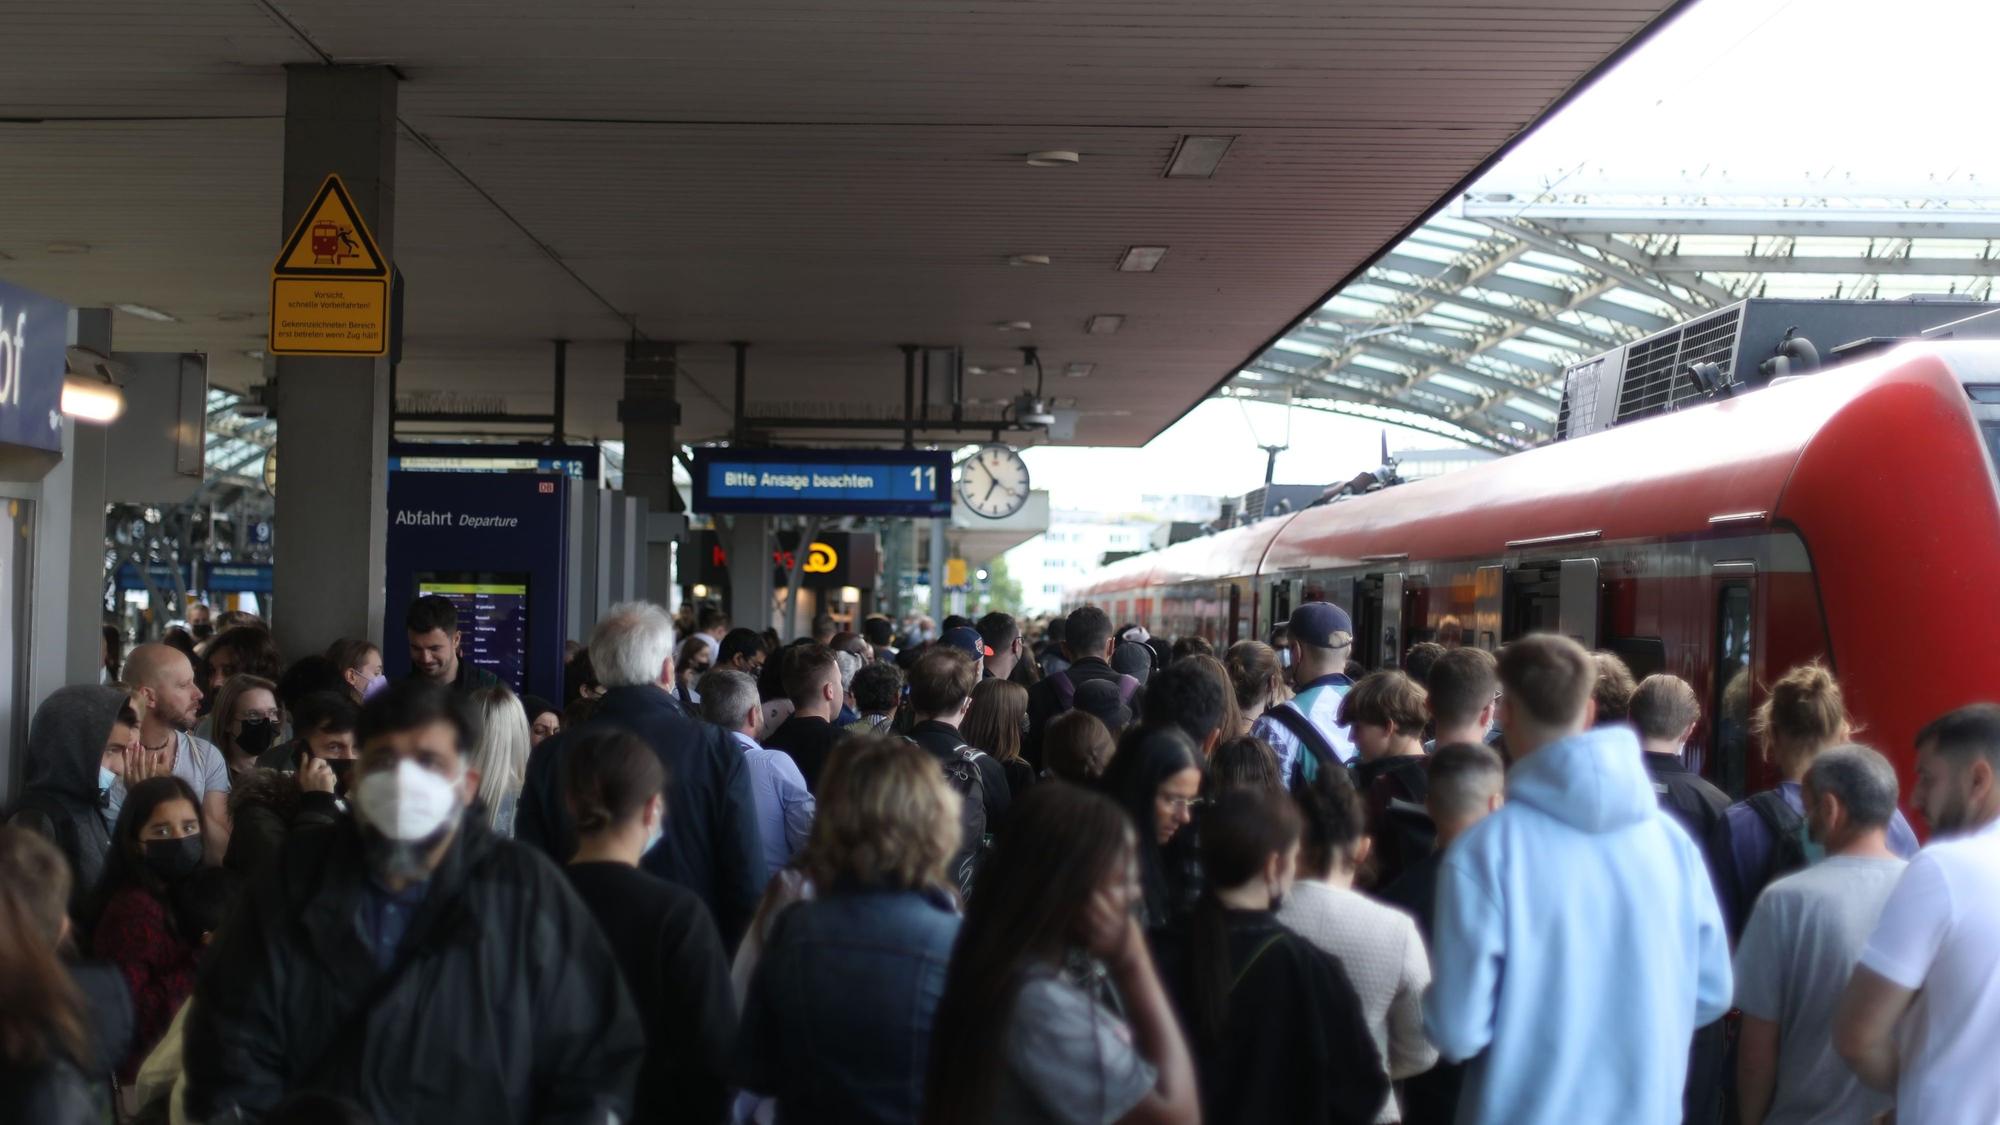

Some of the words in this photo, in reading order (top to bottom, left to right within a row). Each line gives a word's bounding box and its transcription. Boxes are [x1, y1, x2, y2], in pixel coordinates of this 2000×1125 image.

[288, 301, 319, 309] schnelle
[348, 321, 376, 329] Bereich
[346, 332, 361, 340] Zug
[566, 460, 583, 476] 12
[724, 471, 757, 487] Bitte
[760, 472, 809, 490] Ansage
[812, 473, 874, 489] beachten
[910, 465, 937, 492] 11
[395, 510, 452, 526] Abfahrt
[458, 514, 518, 529] Departure
